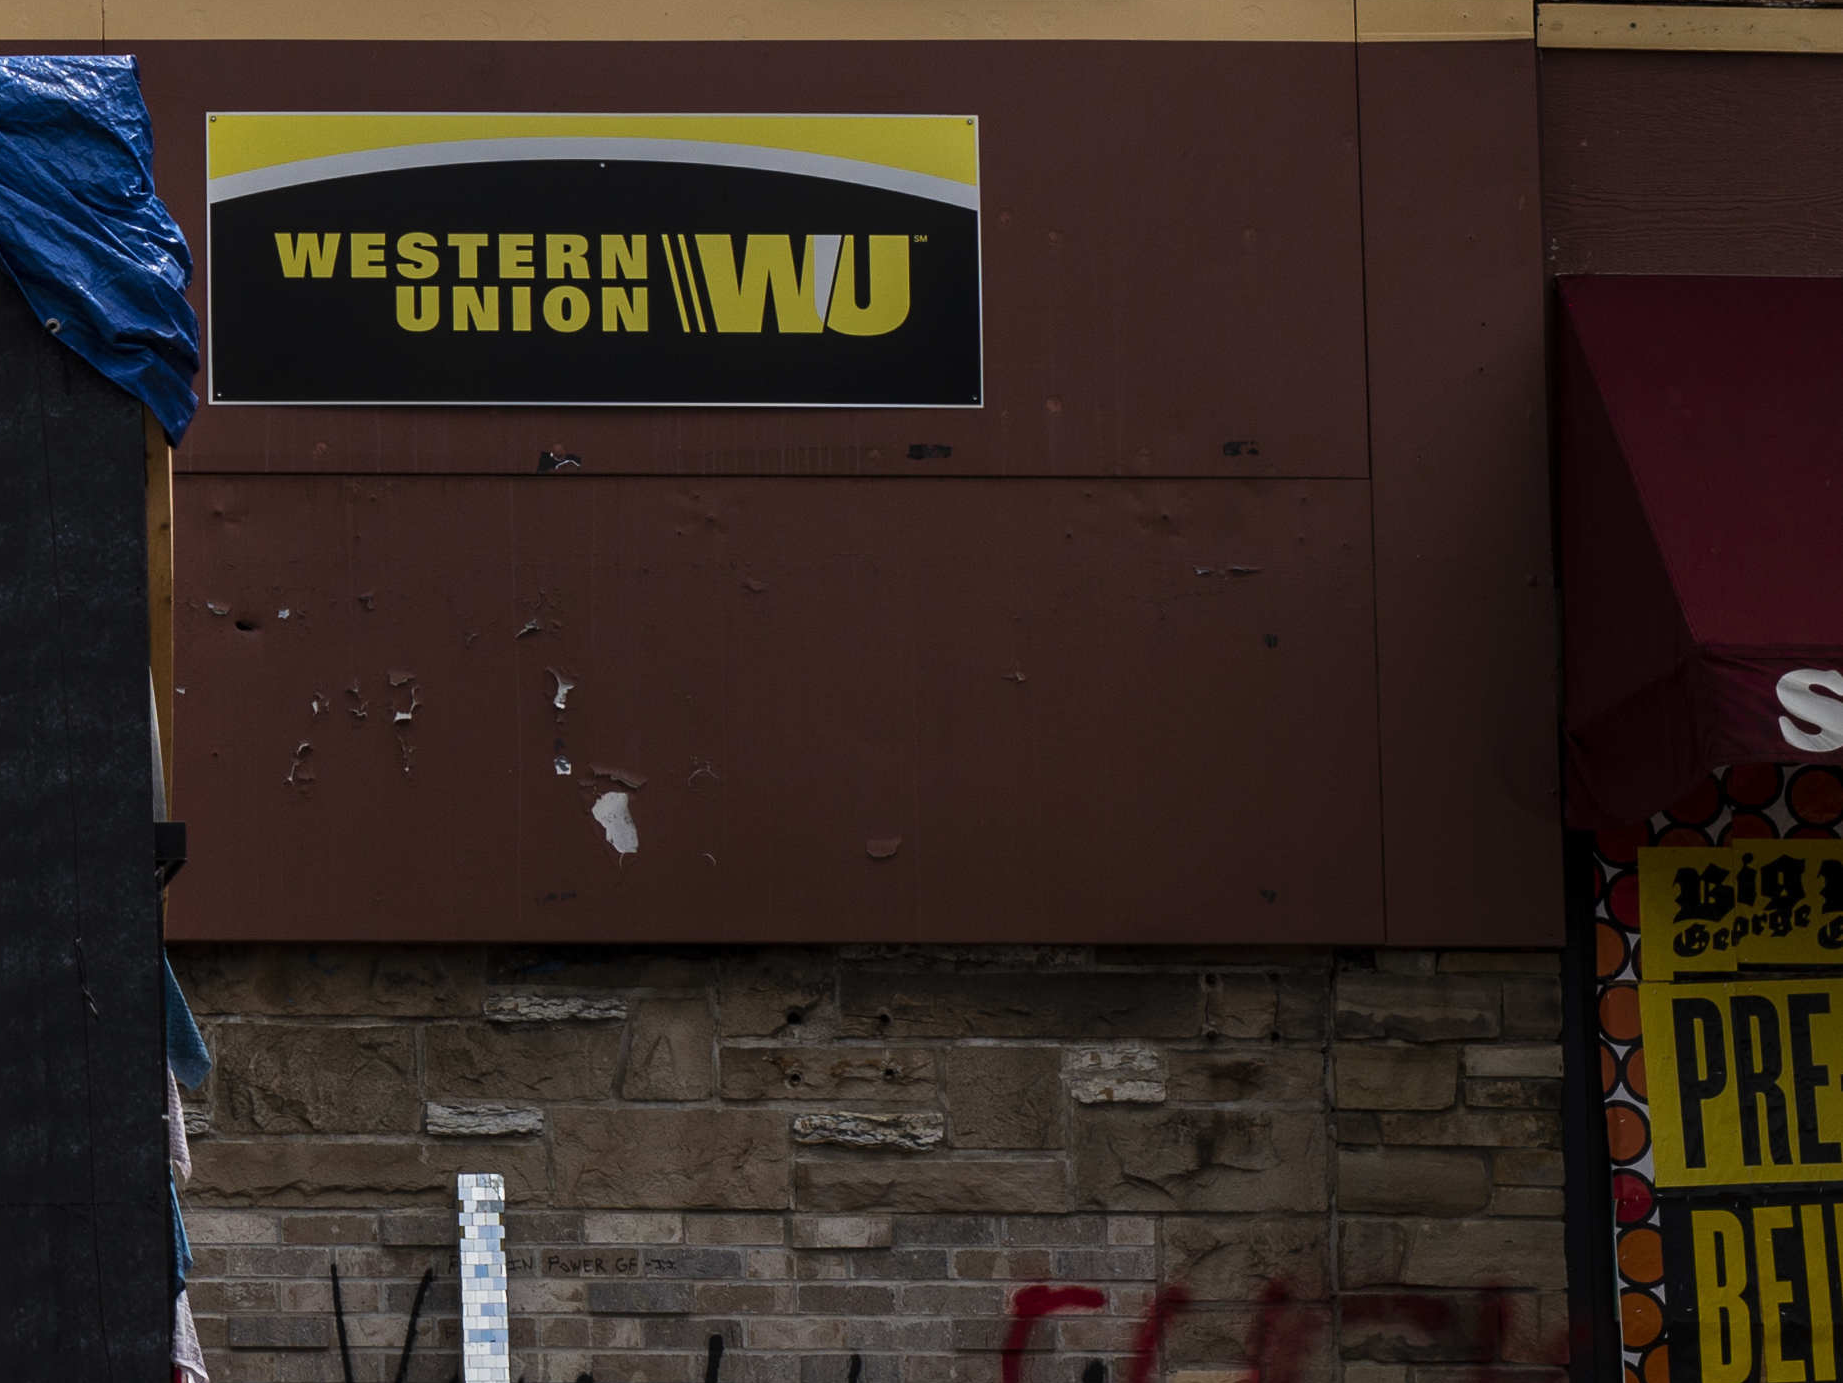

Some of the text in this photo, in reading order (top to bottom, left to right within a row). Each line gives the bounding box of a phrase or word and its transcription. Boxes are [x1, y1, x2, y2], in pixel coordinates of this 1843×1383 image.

[274, 232, 648, 279] WESTERN
[694, 234, 910, 336] WU
[395, 286, 648, 332] UNION
[1673, 904, 1811, 958] George
[548, 1255, 607, 1274] POWER
